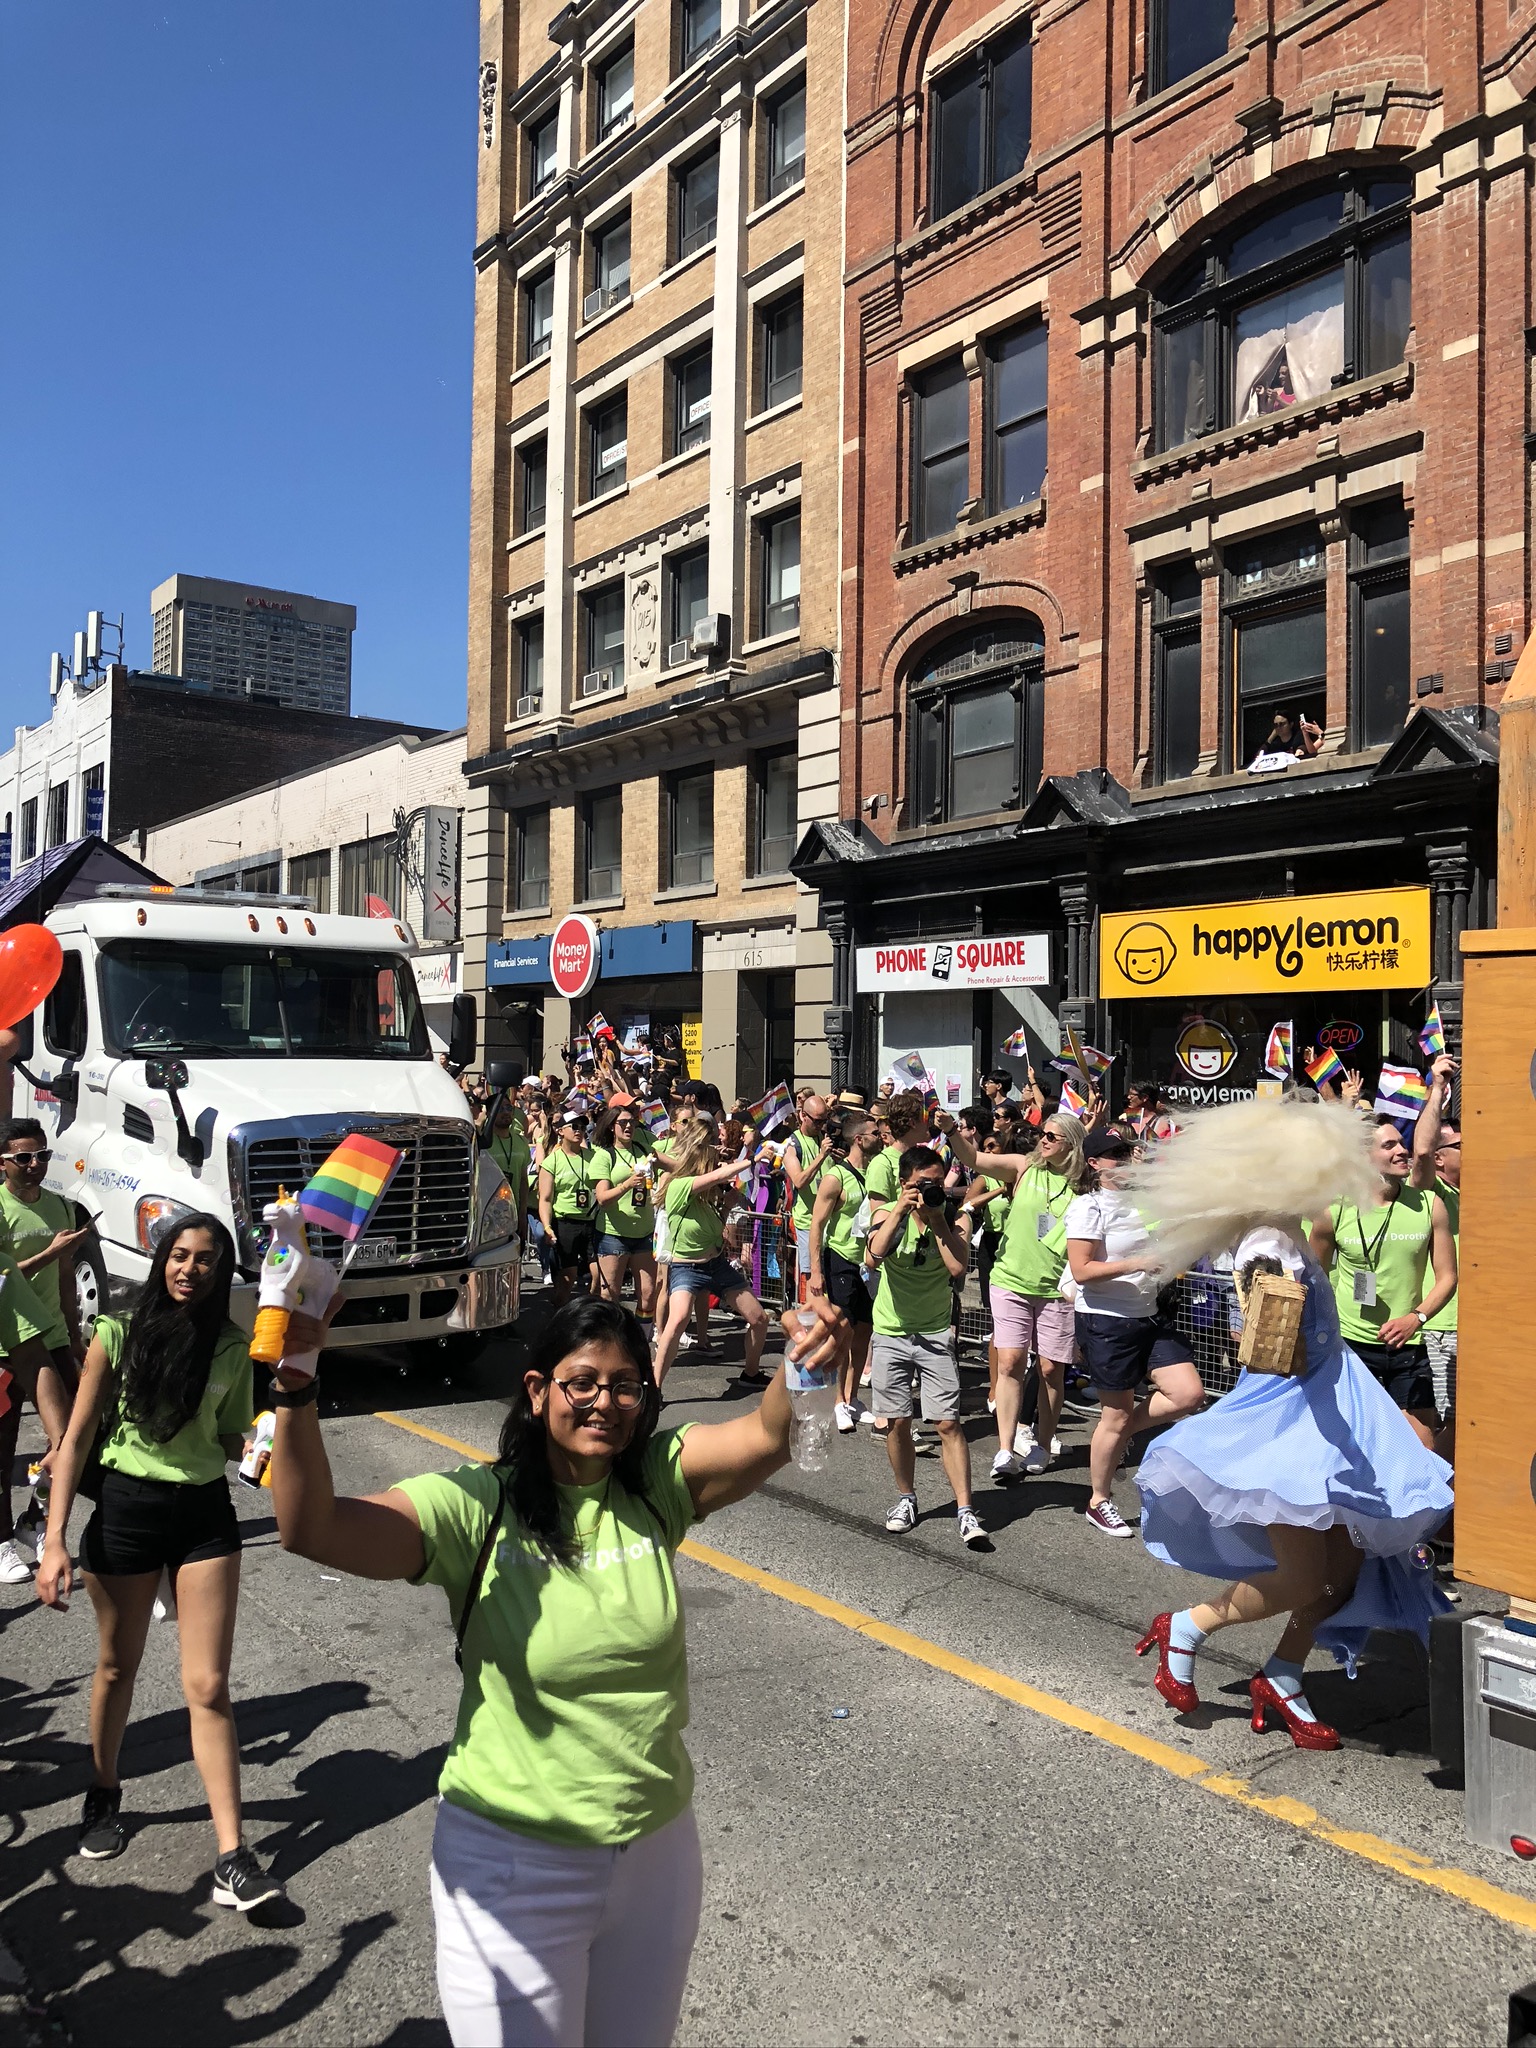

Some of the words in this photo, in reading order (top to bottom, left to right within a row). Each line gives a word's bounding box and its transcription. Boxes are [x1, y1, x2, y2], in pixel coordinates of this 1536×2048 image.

[556, 943, 588, 959] Money
[1193, 916, 1399, 978] happylemon
[494, 957, 516, 968] Financial
[517, 956, 539, 967] Services
[744, 950, 763, 967] 615
[876, 948, 927, 973] PHONE
[956, 941, 1026, 973] SQUARE
[1326, 948, 1400, 972] 快乐柠檬
[559, 958, 581, 974] Mart
[967, 976, 985, 985] Phone
[986, 976, 1004, 985] Repair
[1005, 975, 1011, 983] &
[1012, 974, 1046, 982] Accessories
[1320, 1028, 1360, 1044] OPEN
